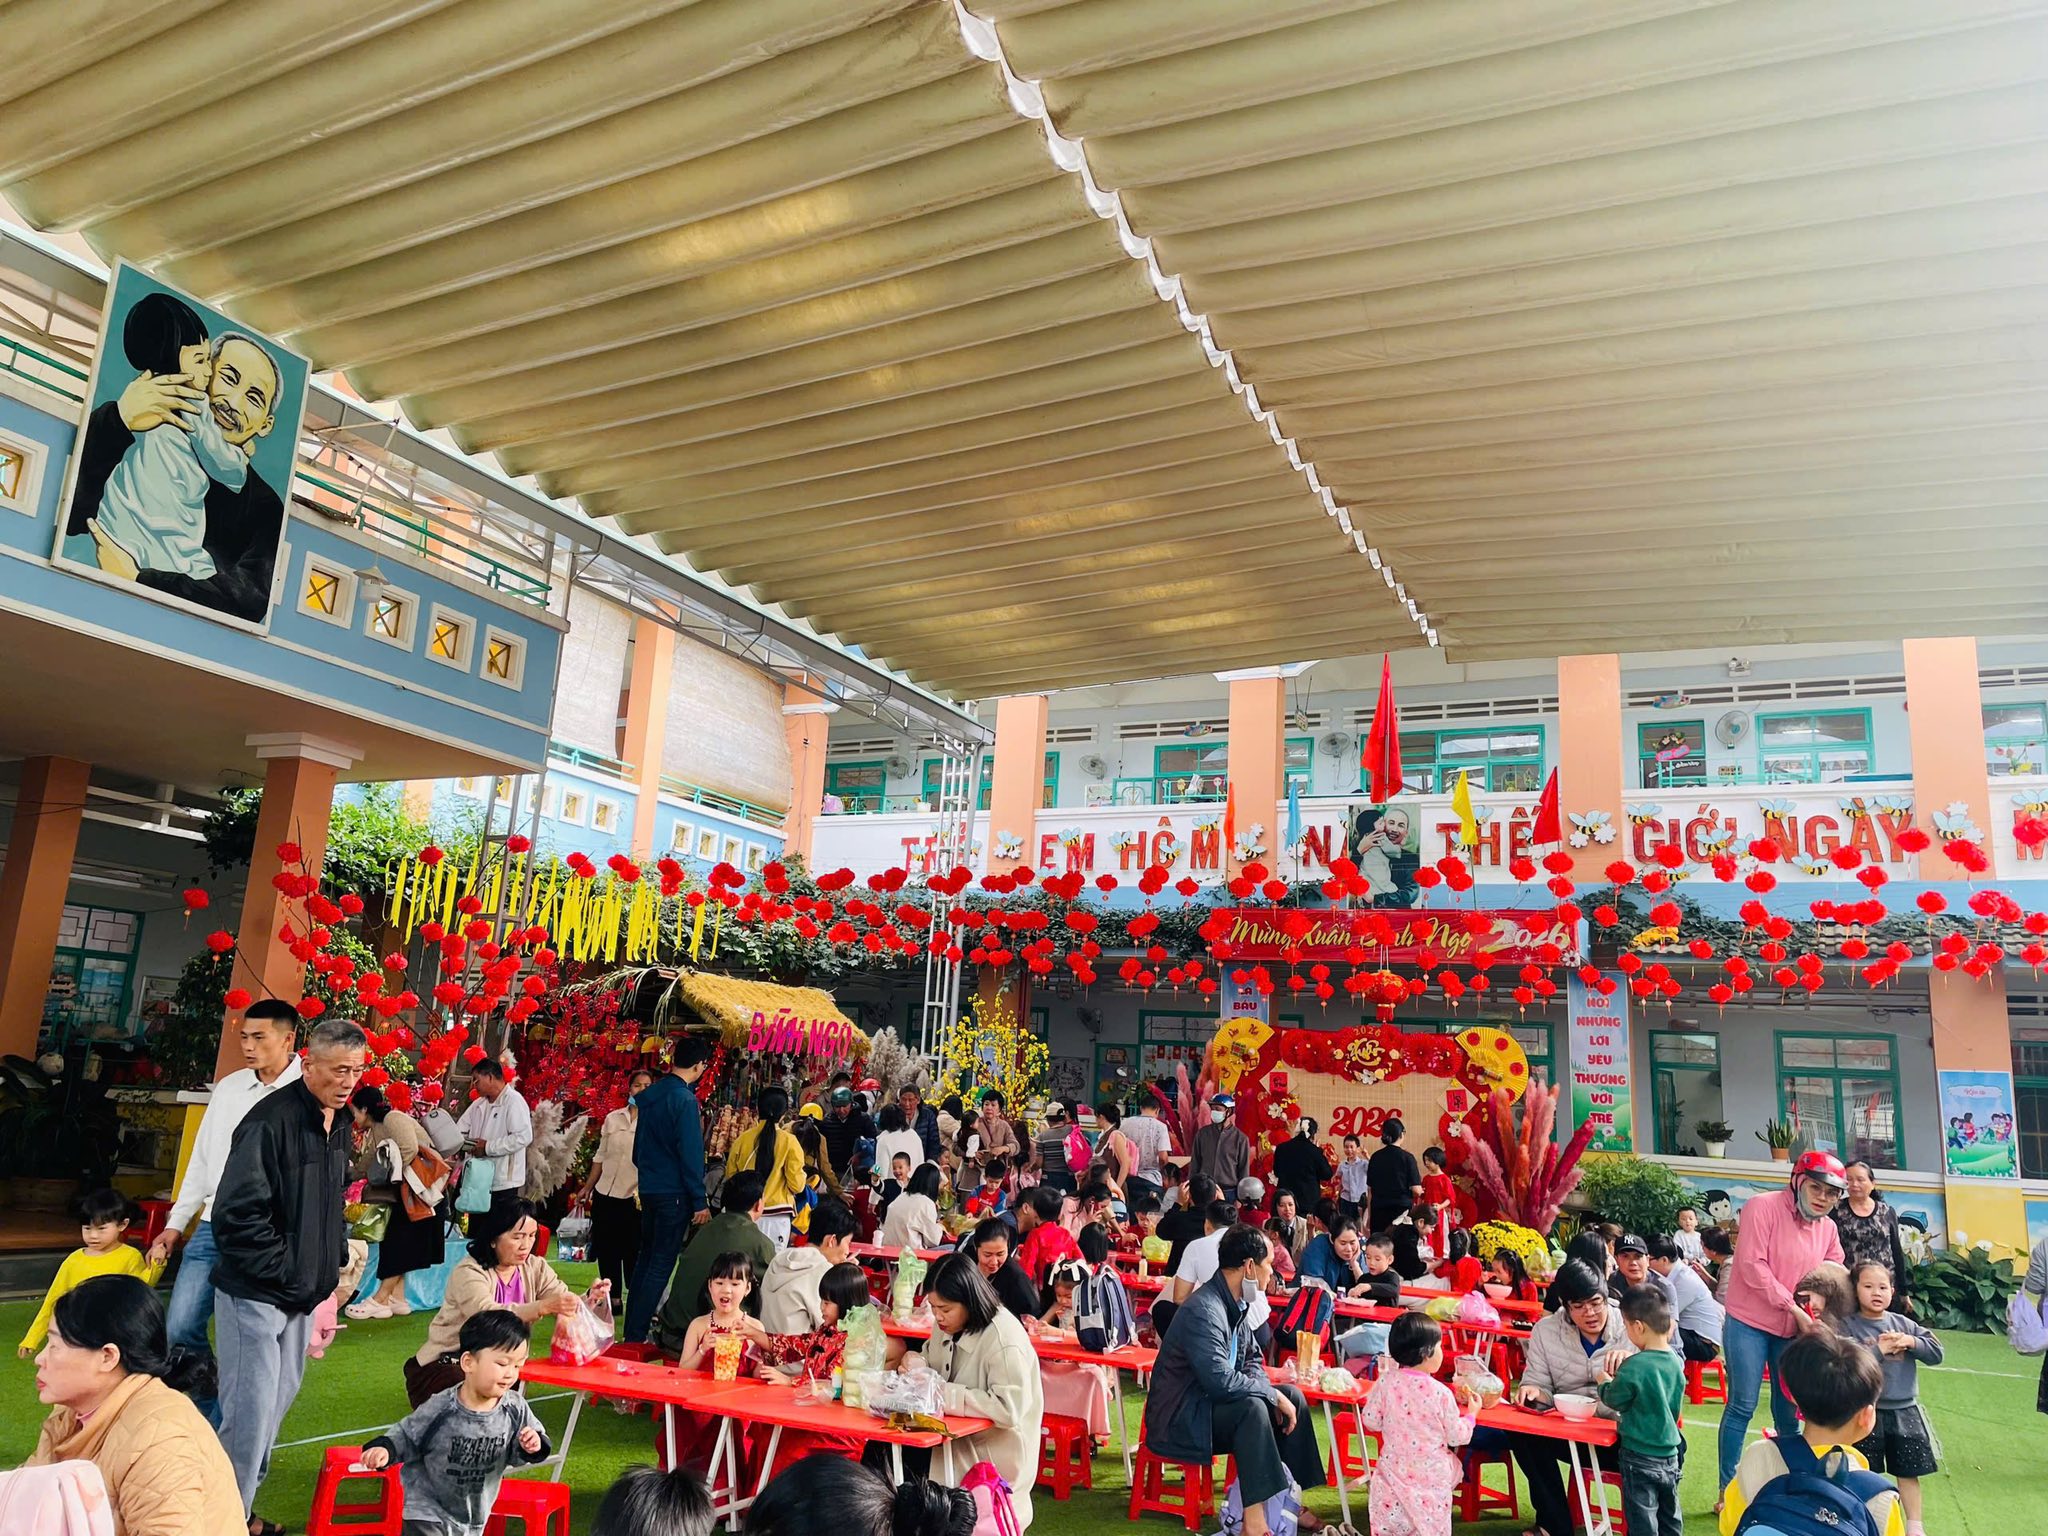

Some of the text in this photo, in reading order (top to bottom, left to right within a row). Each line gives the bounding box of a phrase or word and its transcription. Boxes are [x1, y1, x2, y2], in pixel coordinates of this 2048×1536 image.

[1040, 833, 1095, 871] EM
[1119, 816, 1220, 871] HÔM
[1632, 803, 1737, 863] GIỚI
[1764, 797, 1913, 863] NGÀY
[1230, 916, 1292, 955] Mừng
[1353, 1026, 1382, 1038] 2026
[1575, 1073, 1626, 1085] THƯƠNG
